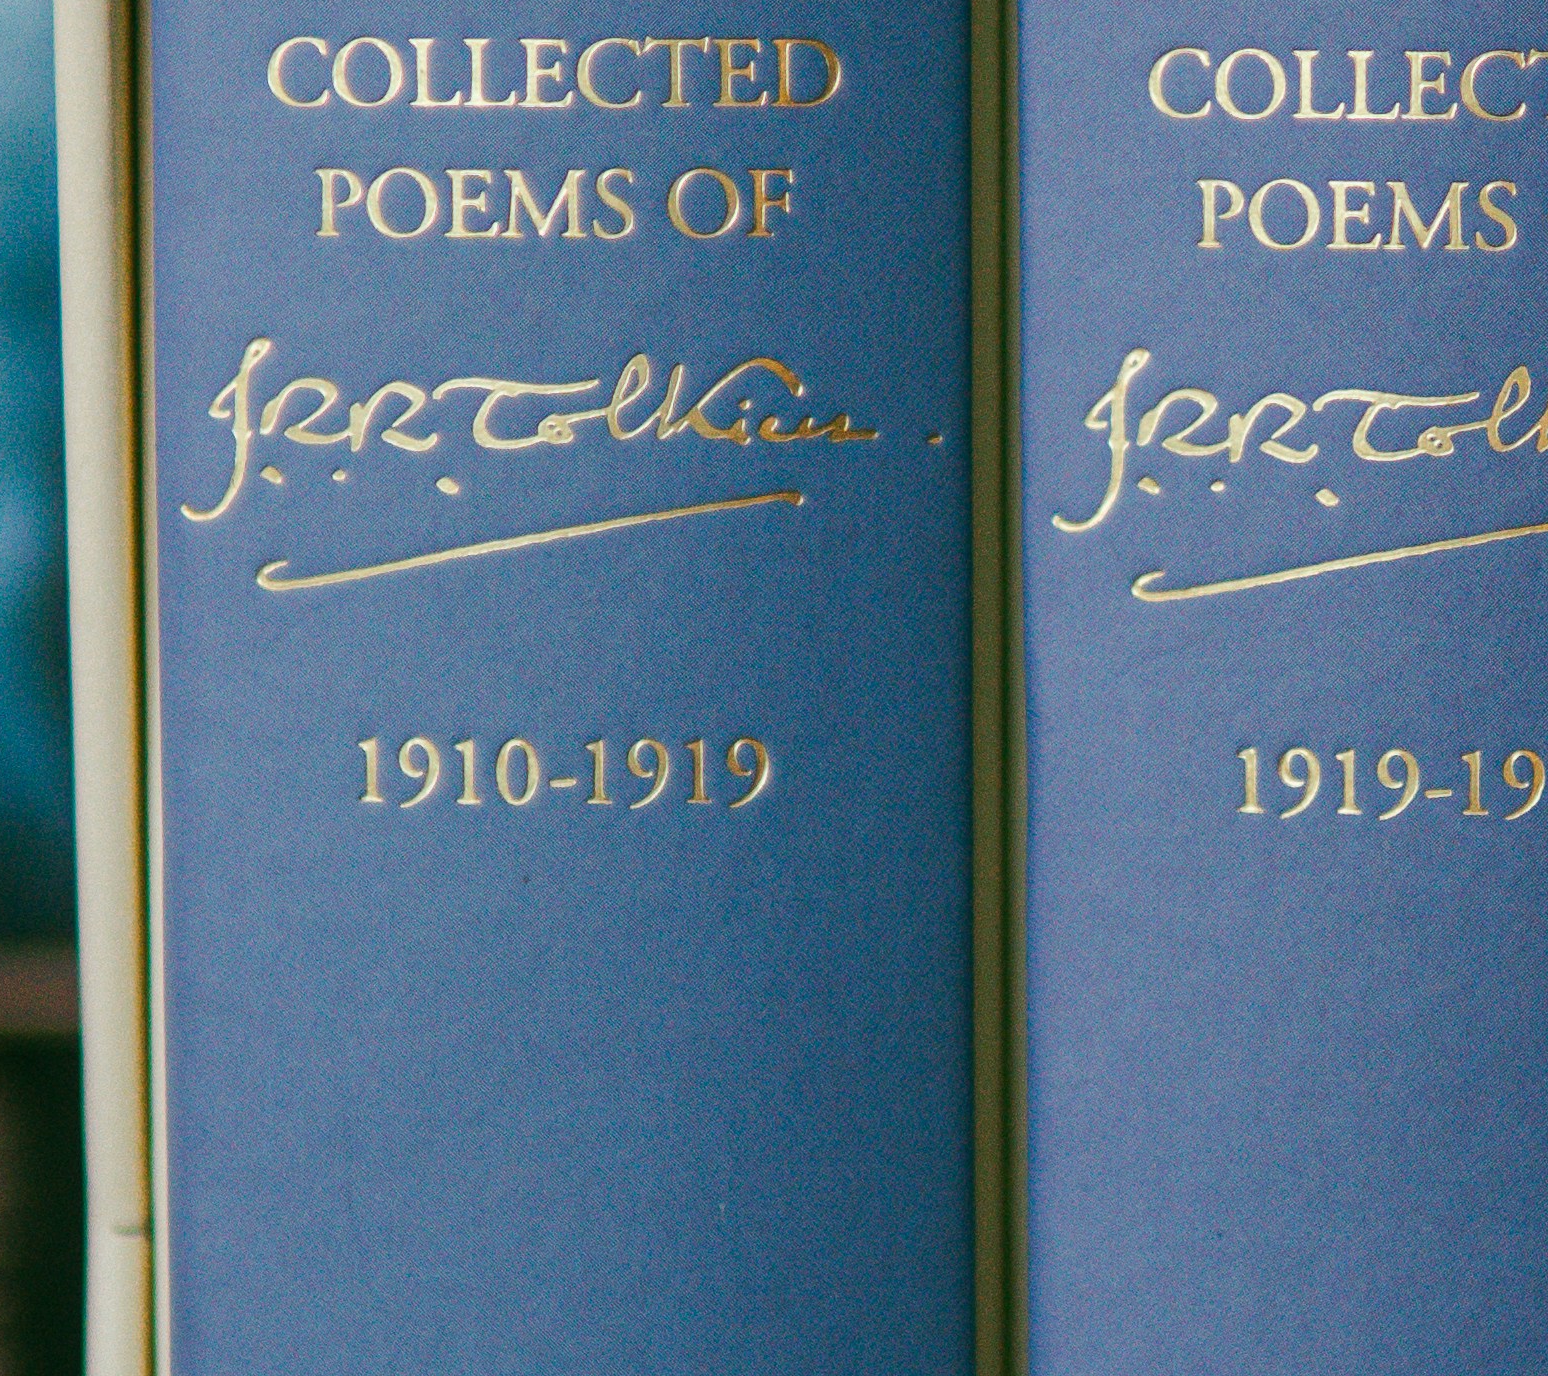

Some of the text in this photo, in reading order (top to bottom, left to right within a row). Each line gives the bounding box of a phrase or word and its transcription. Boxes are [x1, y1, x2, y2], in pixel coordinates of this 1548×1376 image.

[267, 35, 844, 112] COLLECTED
[316, 165, 795, 242] POEMS OF
[1197, 177, 1519, 254] POEMS
[359, 735, 772, 809] 1910-1919
